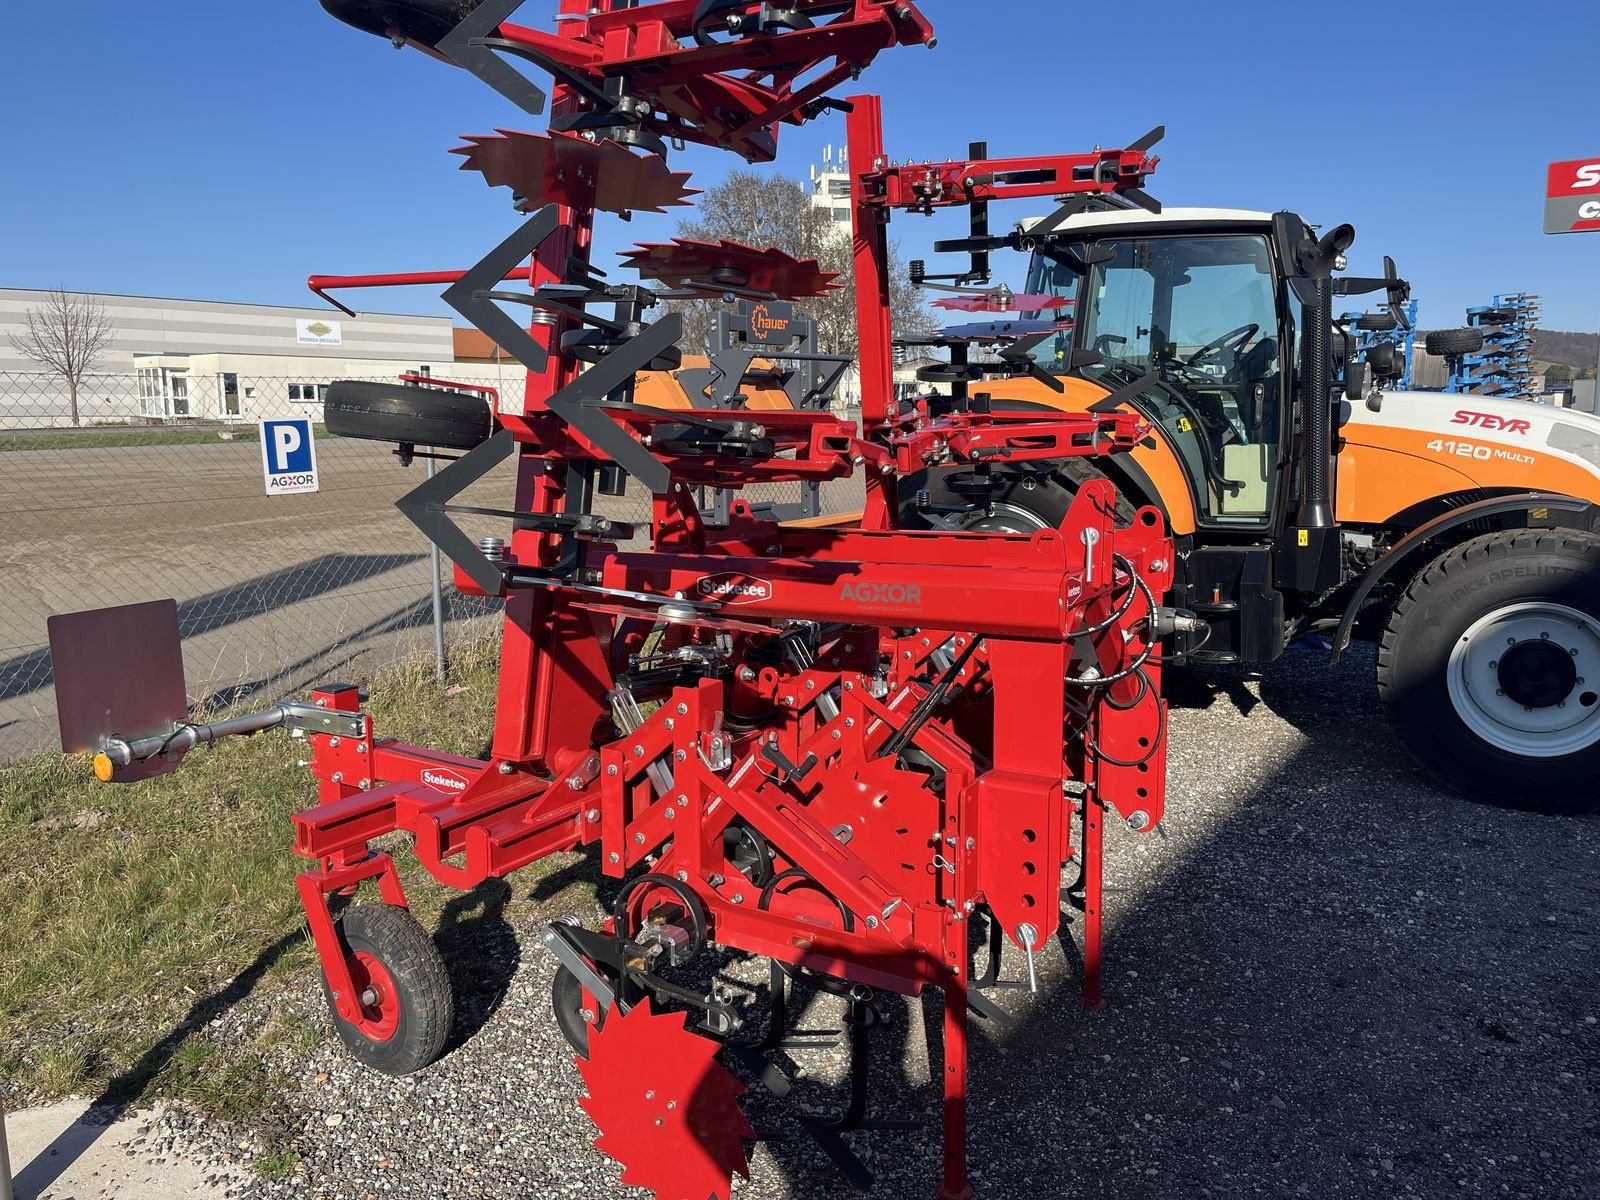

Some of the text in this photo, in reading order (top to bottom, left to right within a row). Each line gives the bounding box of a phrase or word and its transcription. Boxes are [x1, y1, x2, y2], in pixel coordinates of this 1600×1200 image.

[757, 312, 788, 330] hauer
[1449, 410, 1531, 435] STEYR
[273, 425, 301, 470] P
[1426, 439, 1535, 464] 4120 MULTI
[270, 474, 314, 487] AGXOR
[702, 578, 767, 597] Steketee
[839, 582, 922, 604] AGXOR
[424, 771, 466, 790] Steketee
